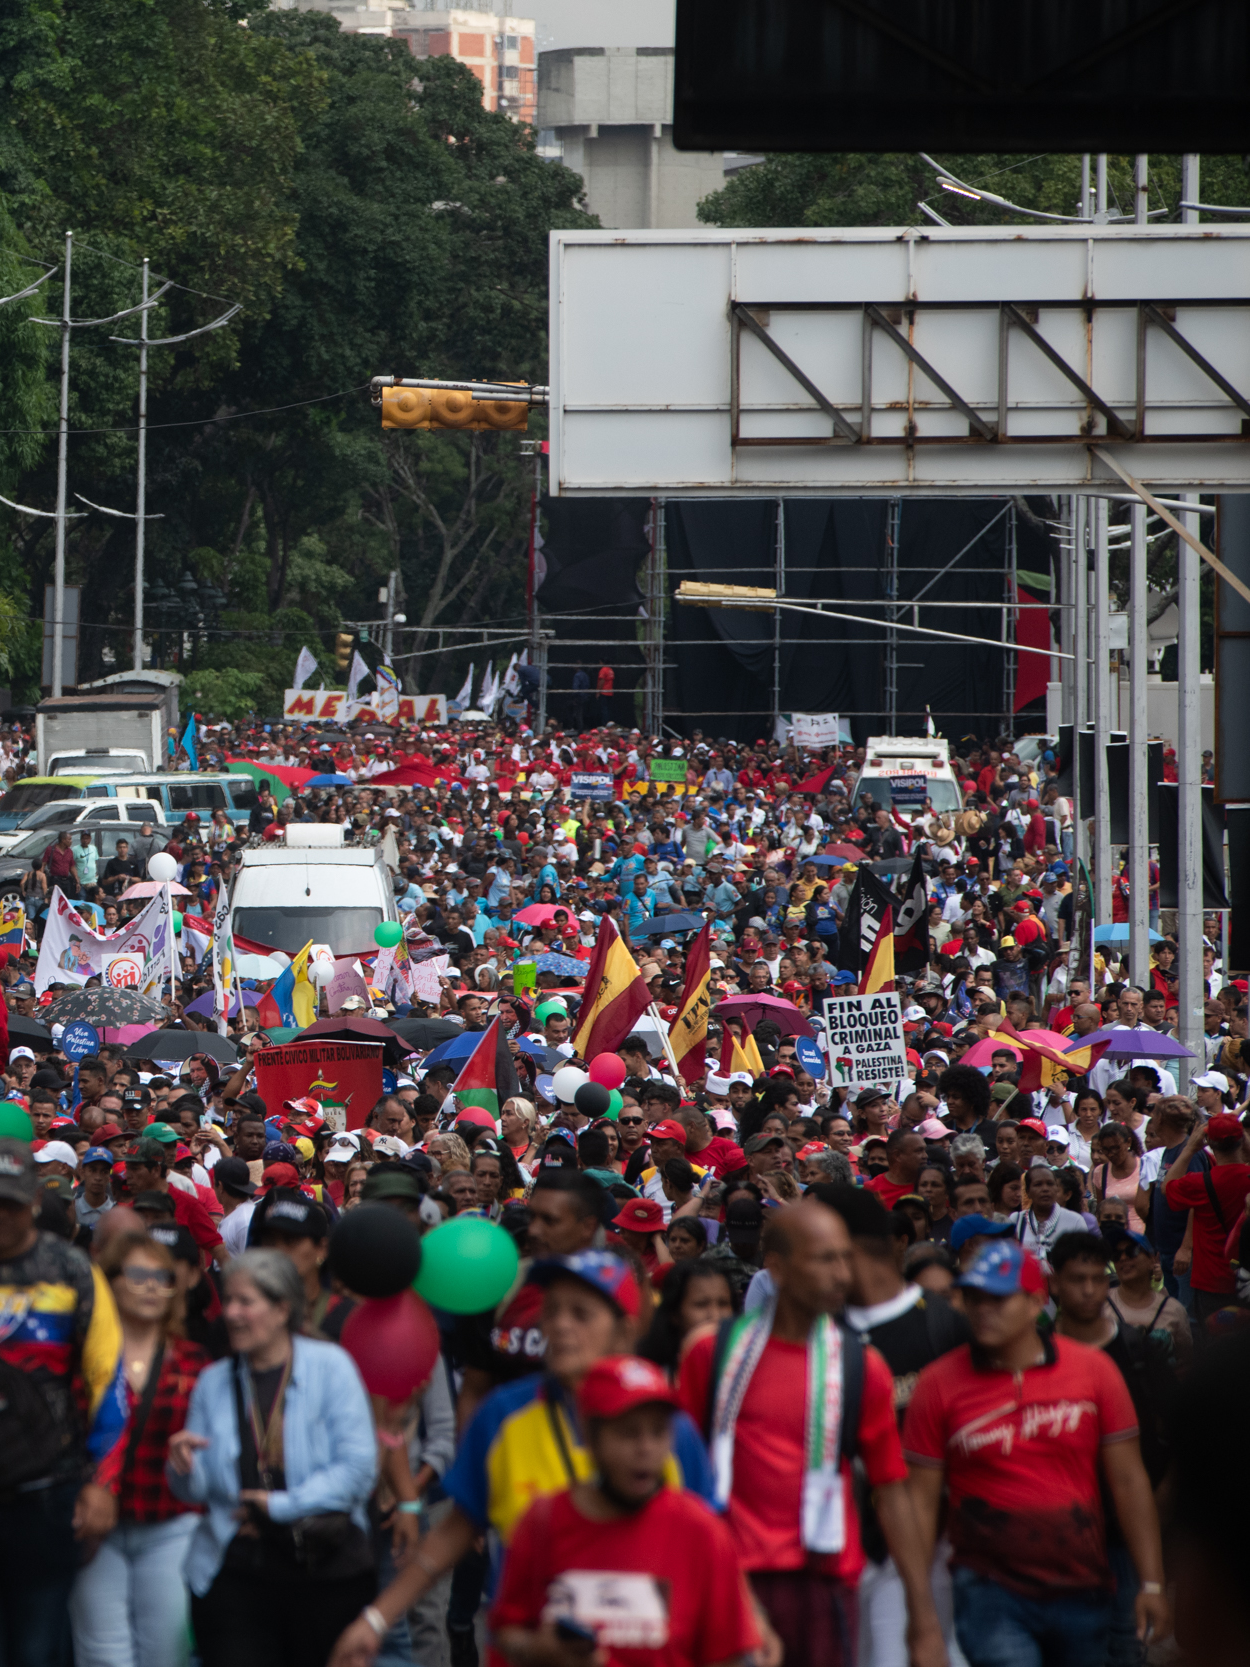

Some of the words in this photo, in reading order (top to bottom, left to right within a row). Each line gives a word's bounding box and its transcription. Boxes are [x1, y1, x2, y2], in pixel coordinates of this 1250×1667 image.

[572, 775, 613, 784] VISIPOL
[890, 777, 927, 788] VISIPOL
[827, 1000, 862, 1014] FIN
[870, 997, 898, 1010] AL
[828, 1009, 899, 1030] BLOQUEO
[73, 1027, 89, 1037] Viva
[831, 1026, 900, 1046] CRIMINAL
[65, 1033, 95, 1047] Palestina
[70, 1043, 89, 1054] Libre
[843, 1046, 852, 1055] A
[855, 1041, 892, 1053] GAZA
[258, 1052, 284, 1066] FRENTE
[309, 1049, 336, 1063] MILITAR
[337, 1046, 380, 1061] BOLIVARIANO
[855, 1055, 903, 1069] PALESTINA
[856, 1065, 905, 1081] RESISTE!
